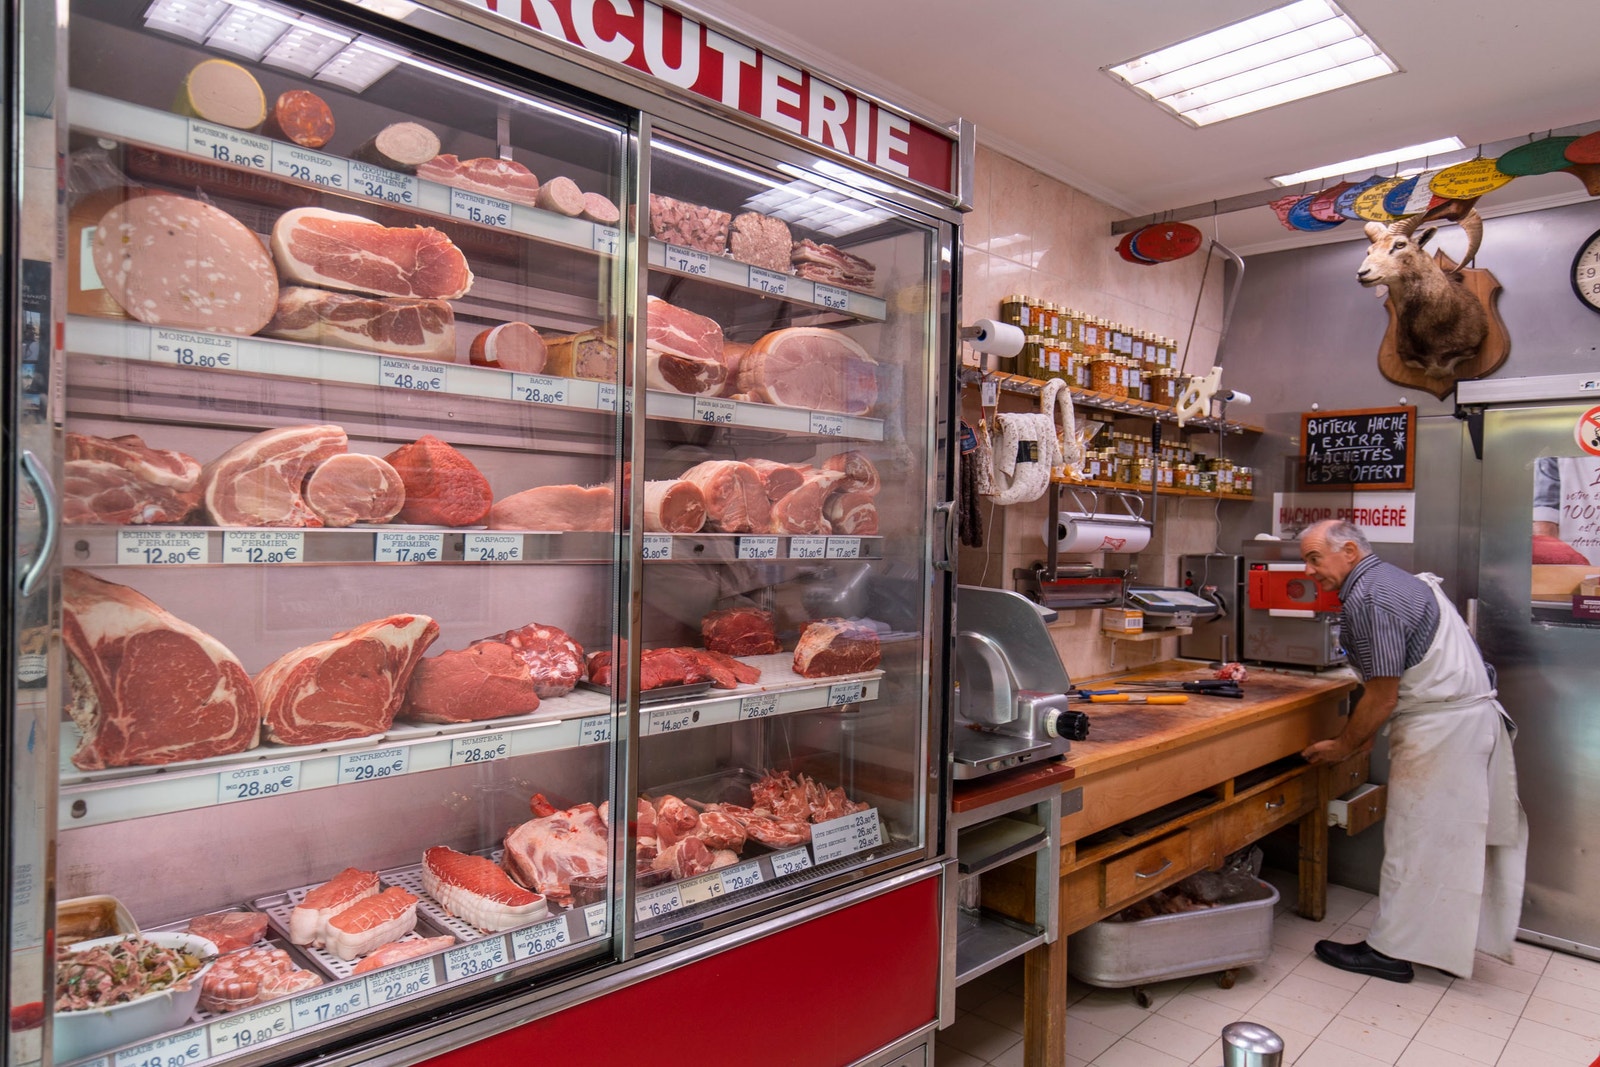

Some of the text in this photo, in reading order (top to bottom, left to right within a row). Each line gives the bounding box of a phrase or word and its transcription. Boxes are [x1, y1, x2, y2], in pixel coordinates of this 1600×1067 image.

[240, 137, 269, 151] CANARD
[211, 144, 265, 168] 18.80€
[291, 151, 332, 167] CHORIZO
[290, 164, 342, 187] 28.80€
[353, 164, 400, 180] ANDOUILLE
[365, 182, 412, 203] 34.80€
[454, 191, 486, 205] POITRINE
[468, 207, 507, 226] 15.80€
[679, 260, 707, 274] 17.80€
[1587, 268, 1596, 278] 9
[761, 281, 784, 294] 17.80€
[824, 296, 847, 309] 15.80€
[159, 332, 232, 347] MORTADELLE
[174, 348, 231, 368] 18.80€
[384, 360, 410, 369] JAMBON
[421, 365, 444, 373] PARME
[395, 374, 441, 390] 48.80€
[530, 377, 553, 385] BACON
[525, 388, 564, 403] 28.80€
[703, 411, 732, 423] 48.80€
[1367, 413, 1408, 434] HACHÉ
[1322, 448, 1394, 466] ACHETÉS
[1350, 464, 1405, 482] OFFERT
[1279, 507, 1332, 525] HACHOIR
[138, 539, 190, 547] FERMIER
[166, 531, 176, 539] de
[179, 532, 205, 540] PORC
[229, 531, 300, 541] CÔTE de PORC
[241, 539, 288, 548] FERMIER
[419, 534, 440, 542] PORC
[391, 540, 431, 549] FERMIER
[143, 547, 201, 564] 12.80€
[246, 547, 297, 563] 12.80€
[396, 548, 437, 562] 17.80€
[480, 547, 519, 561] 24.80€
[749, 547, 774, 559] 31.80€
[800, 547, 822, 559] 31.80€
[836, 547, 857, 559] 17.80€
[748, 704, 775, 718] 26.80€
[661, 716, 689, 732] 14.80€
[462, 734, 503, 746] RUMSTEAK
[349, 749, 402, 763] ENTRECÔTE
[464, 744, 506, 763] 28.80€
[232, 768, 259, 779] CÔTE
[355, 760, 403, 781] 29.80€
[238, 776, 294, 798] 28.80€
[783, 857, 809, 873] 32.80€
[731, 870, 760, 890] 29.80€
[708, 882, 721, 898] 1€
[649, 896, 679, 916] 16.80€
[545, 917, 563, 928] VEAU
[524, 926, 556, 940] COCOTTE
[480, 937, 501, 948] VEAU
[526, 931, 565, 955] 26.80€
[450, 953, 470, 964] NOIX
[484, 944, 501, 953] CASI
[460, 951, 502, 976] 33.80€
[372, 964, 430, 988] BLANQUETTE
[295, 989, 333, 1006] PAUPIETTE
[344, 980, 362, 992] VEAU
[385, 972, 431, 1001] 22.80€
[314, 993, 361, 1021] 17.80€
[219, 1005, 281, 1030] OSSO BUCCO
[233, 1018, 286, 1048] 19.80€
[119, 1042, 153, 1060] SALADE
